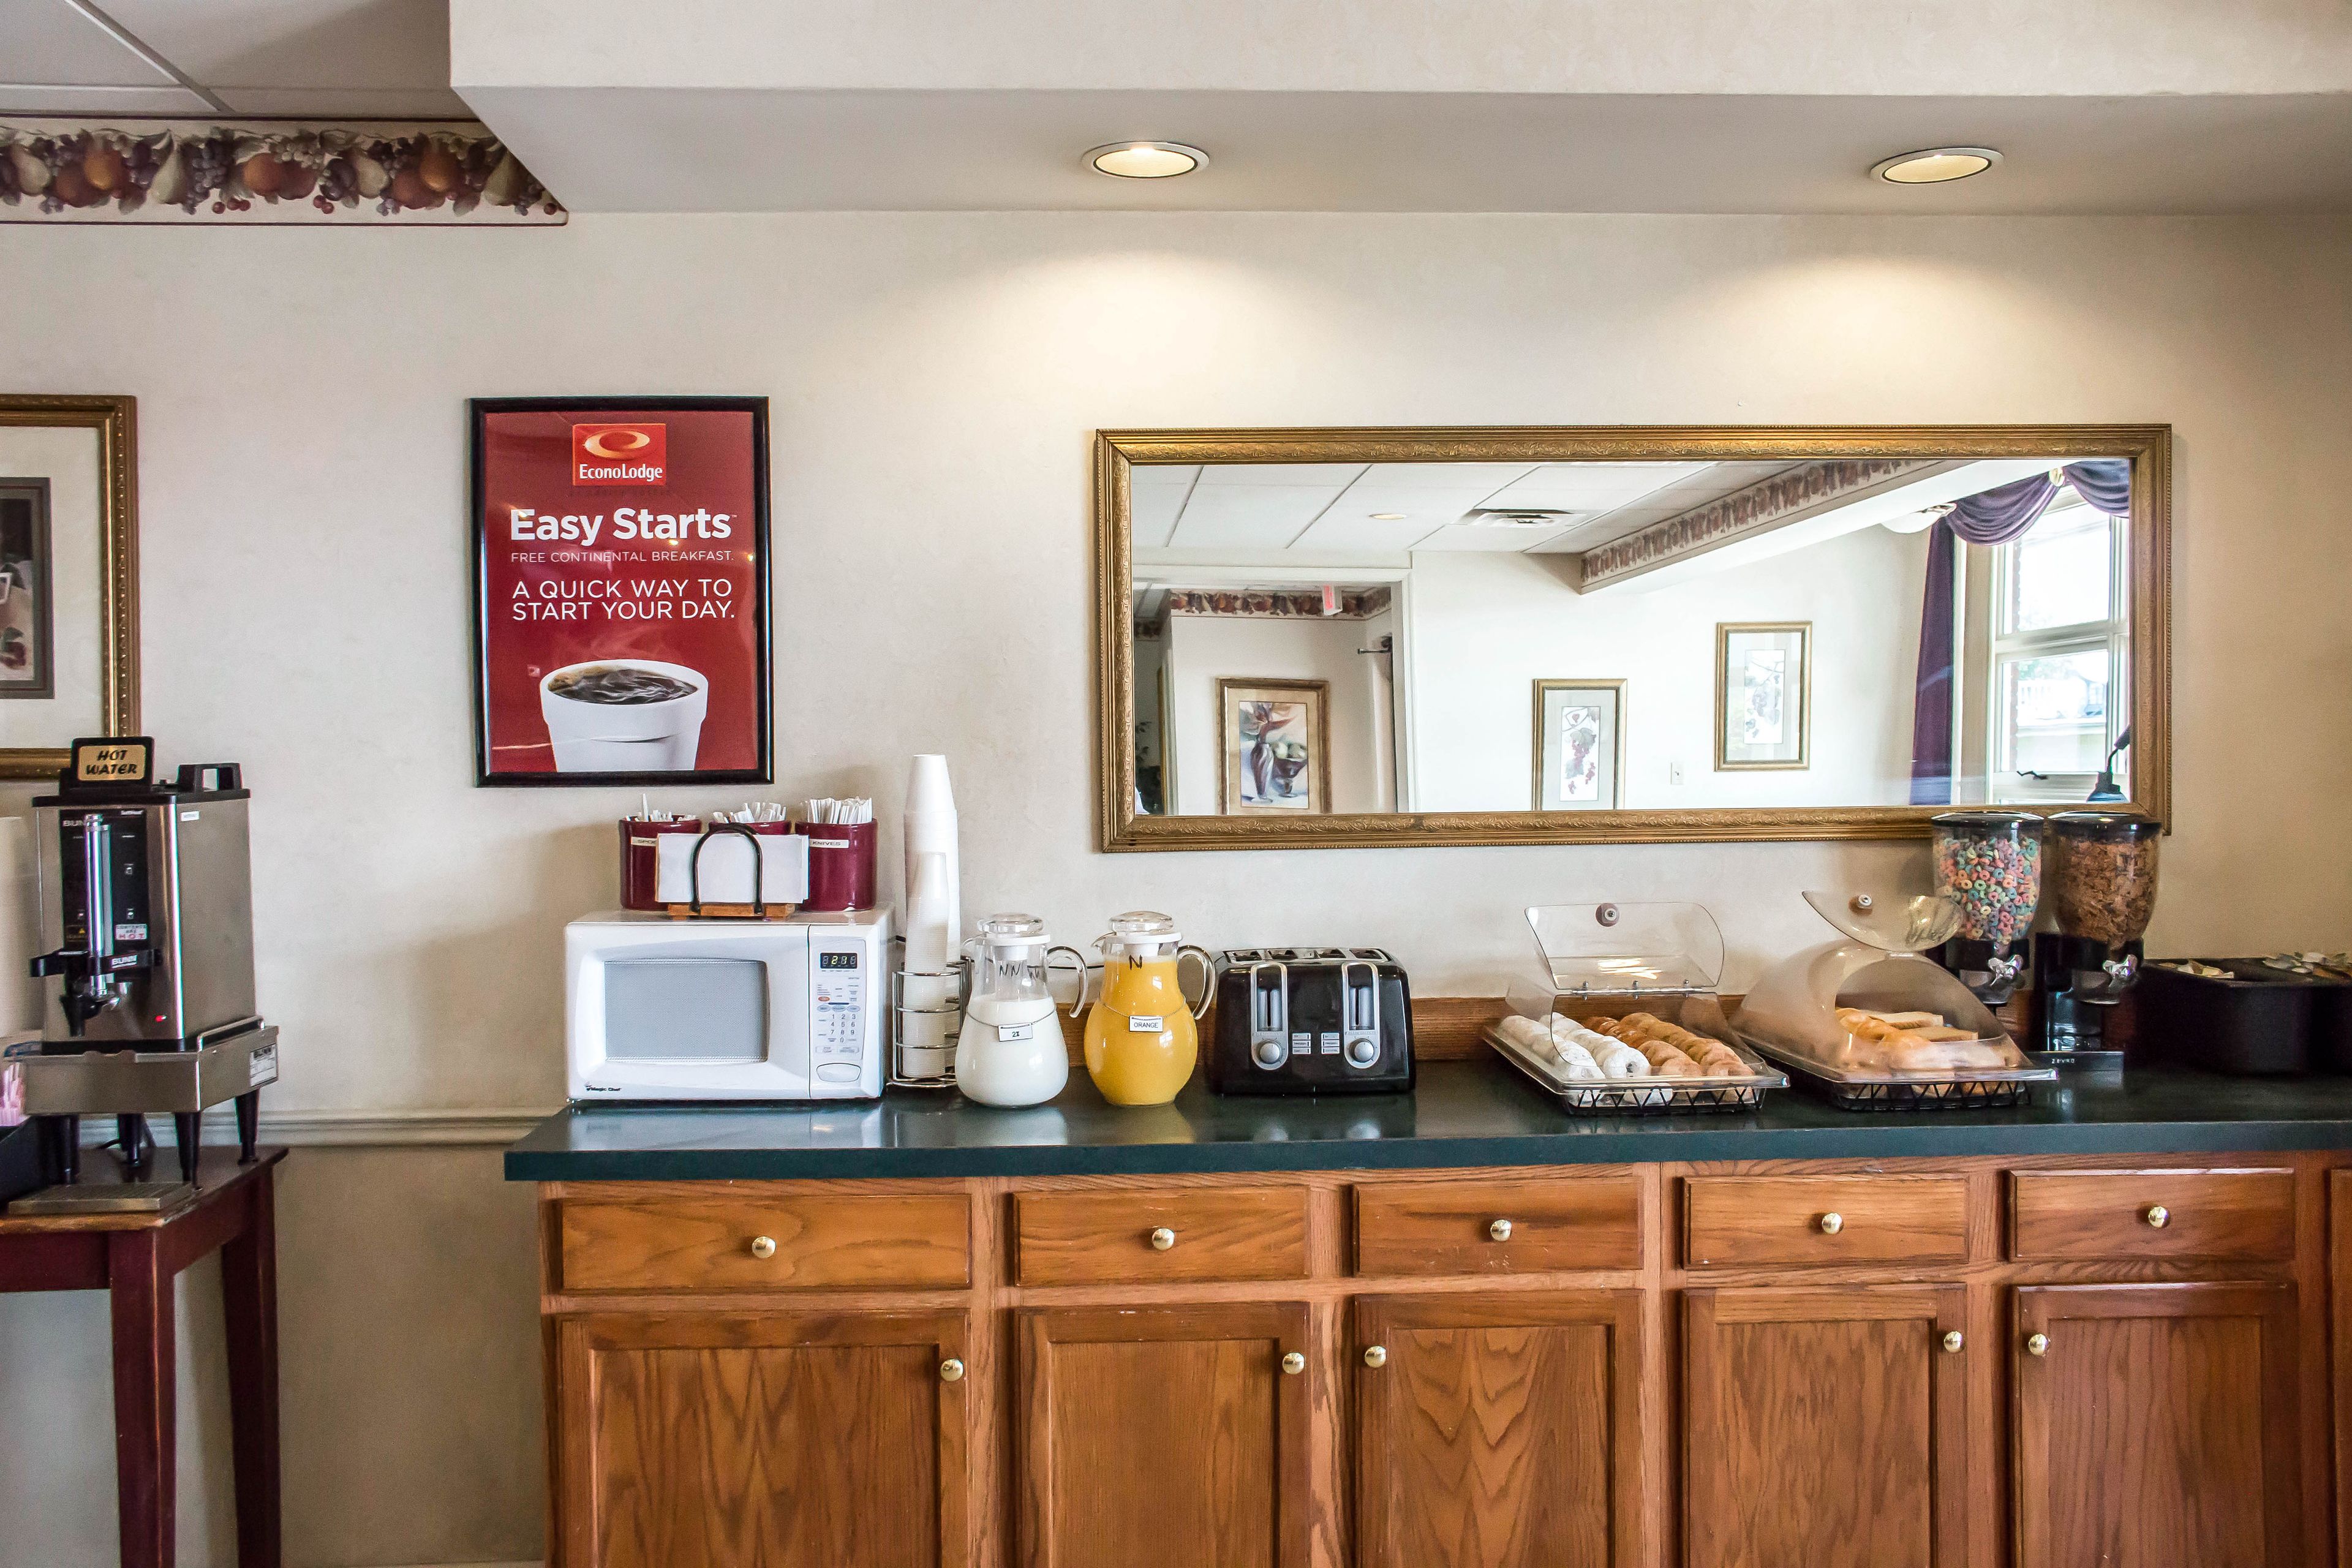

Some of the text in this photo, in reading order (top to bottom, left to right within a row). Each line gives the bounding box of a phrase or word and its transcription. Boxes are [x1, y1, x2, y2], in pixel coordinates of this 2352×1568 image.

[579, 463, 663, 482] EconoLodge
[510, 508, 732, 546] Easy Starts
[511, 551, 734, 562] FREE CONTINENTAL BREAKFAST.
[512, 579, 732, 599] A QUICK WAY TO
[513, 600, 735, 620] START YOUR DAY.
[97, 750, 129, 761] HOT
[86, 764, 137, 775] WATER
